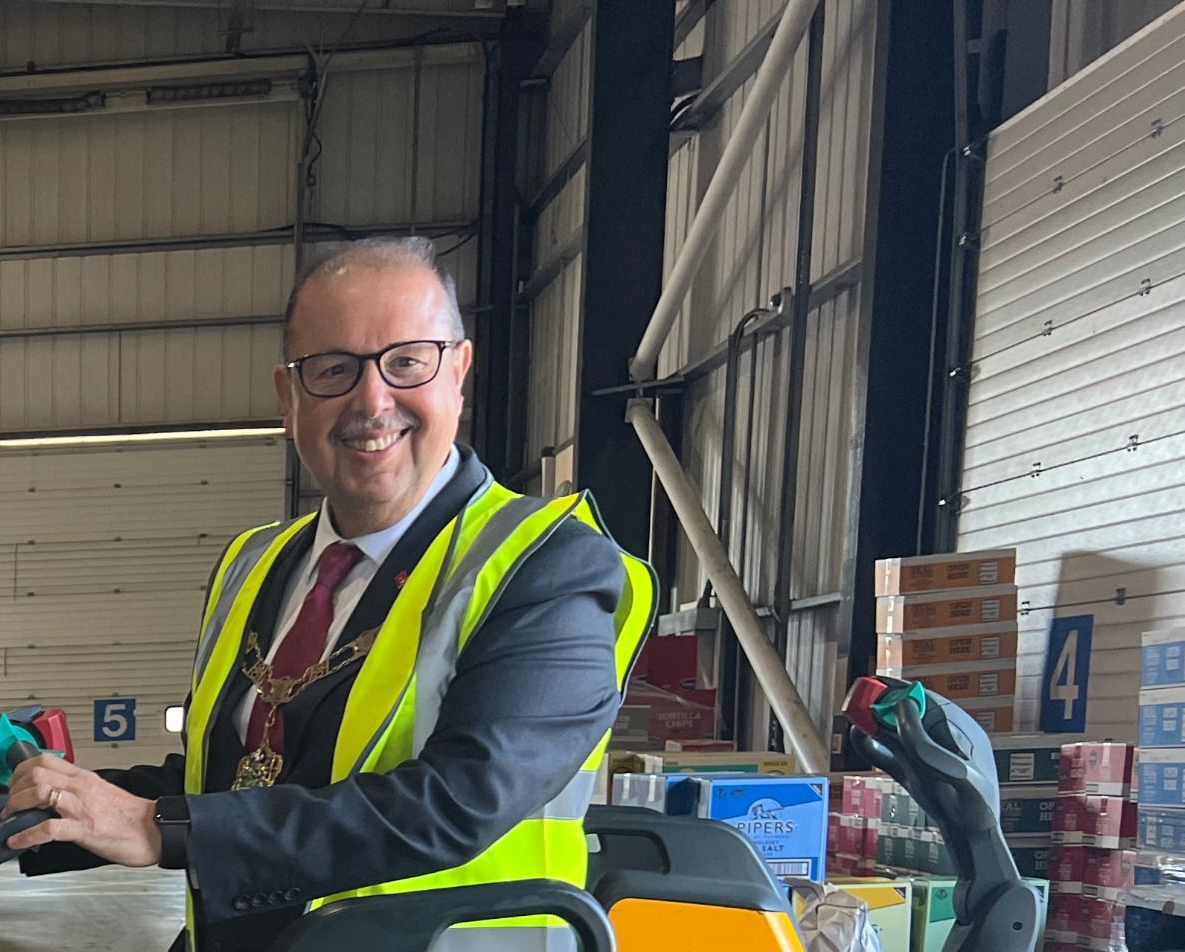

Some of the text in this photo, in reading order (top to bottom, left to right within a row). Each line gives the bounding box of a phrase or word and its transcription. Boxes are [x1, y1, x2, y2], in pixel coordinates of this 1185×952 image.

[1050, 629, 1079, 720] 4
[102, 704, 128, 737] 5
[657, 711, 701, 720] TORTILLA
[665, 721, 694, 729] CHIPS
[737, 820, 794, 834] PIPERS
